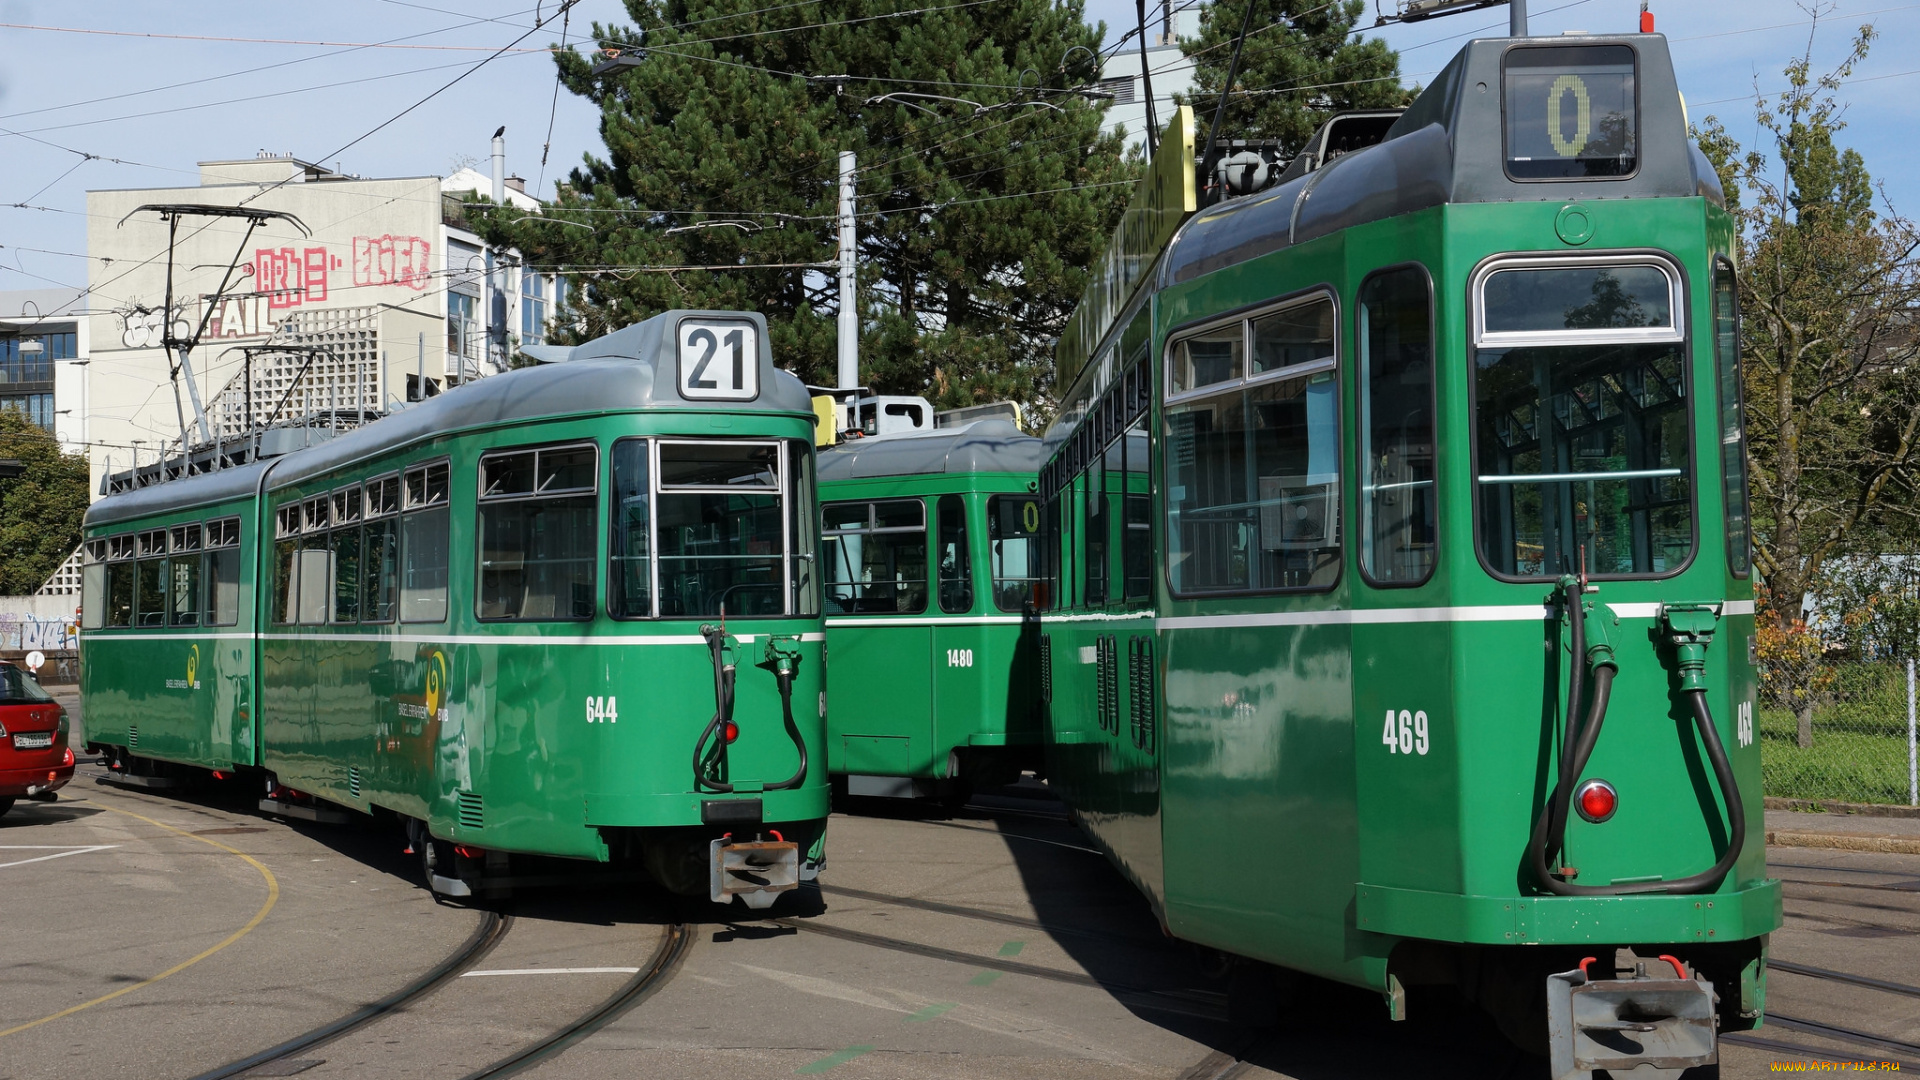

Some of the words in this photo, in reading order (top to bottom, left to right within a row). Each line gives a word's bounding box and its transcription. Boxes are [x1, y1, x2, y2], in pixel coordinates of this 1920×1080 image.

[1547, 75, 1590, 157] 0
[687, 328, 743, 390] 21
[1023, 501, 1039, 533] 0
[947, 649, 973, 667] 1480
[586, 695, 618, 723] 644
[1382, 709, 1429, 755] 469
[1737, 700, 1753, 749] 469
